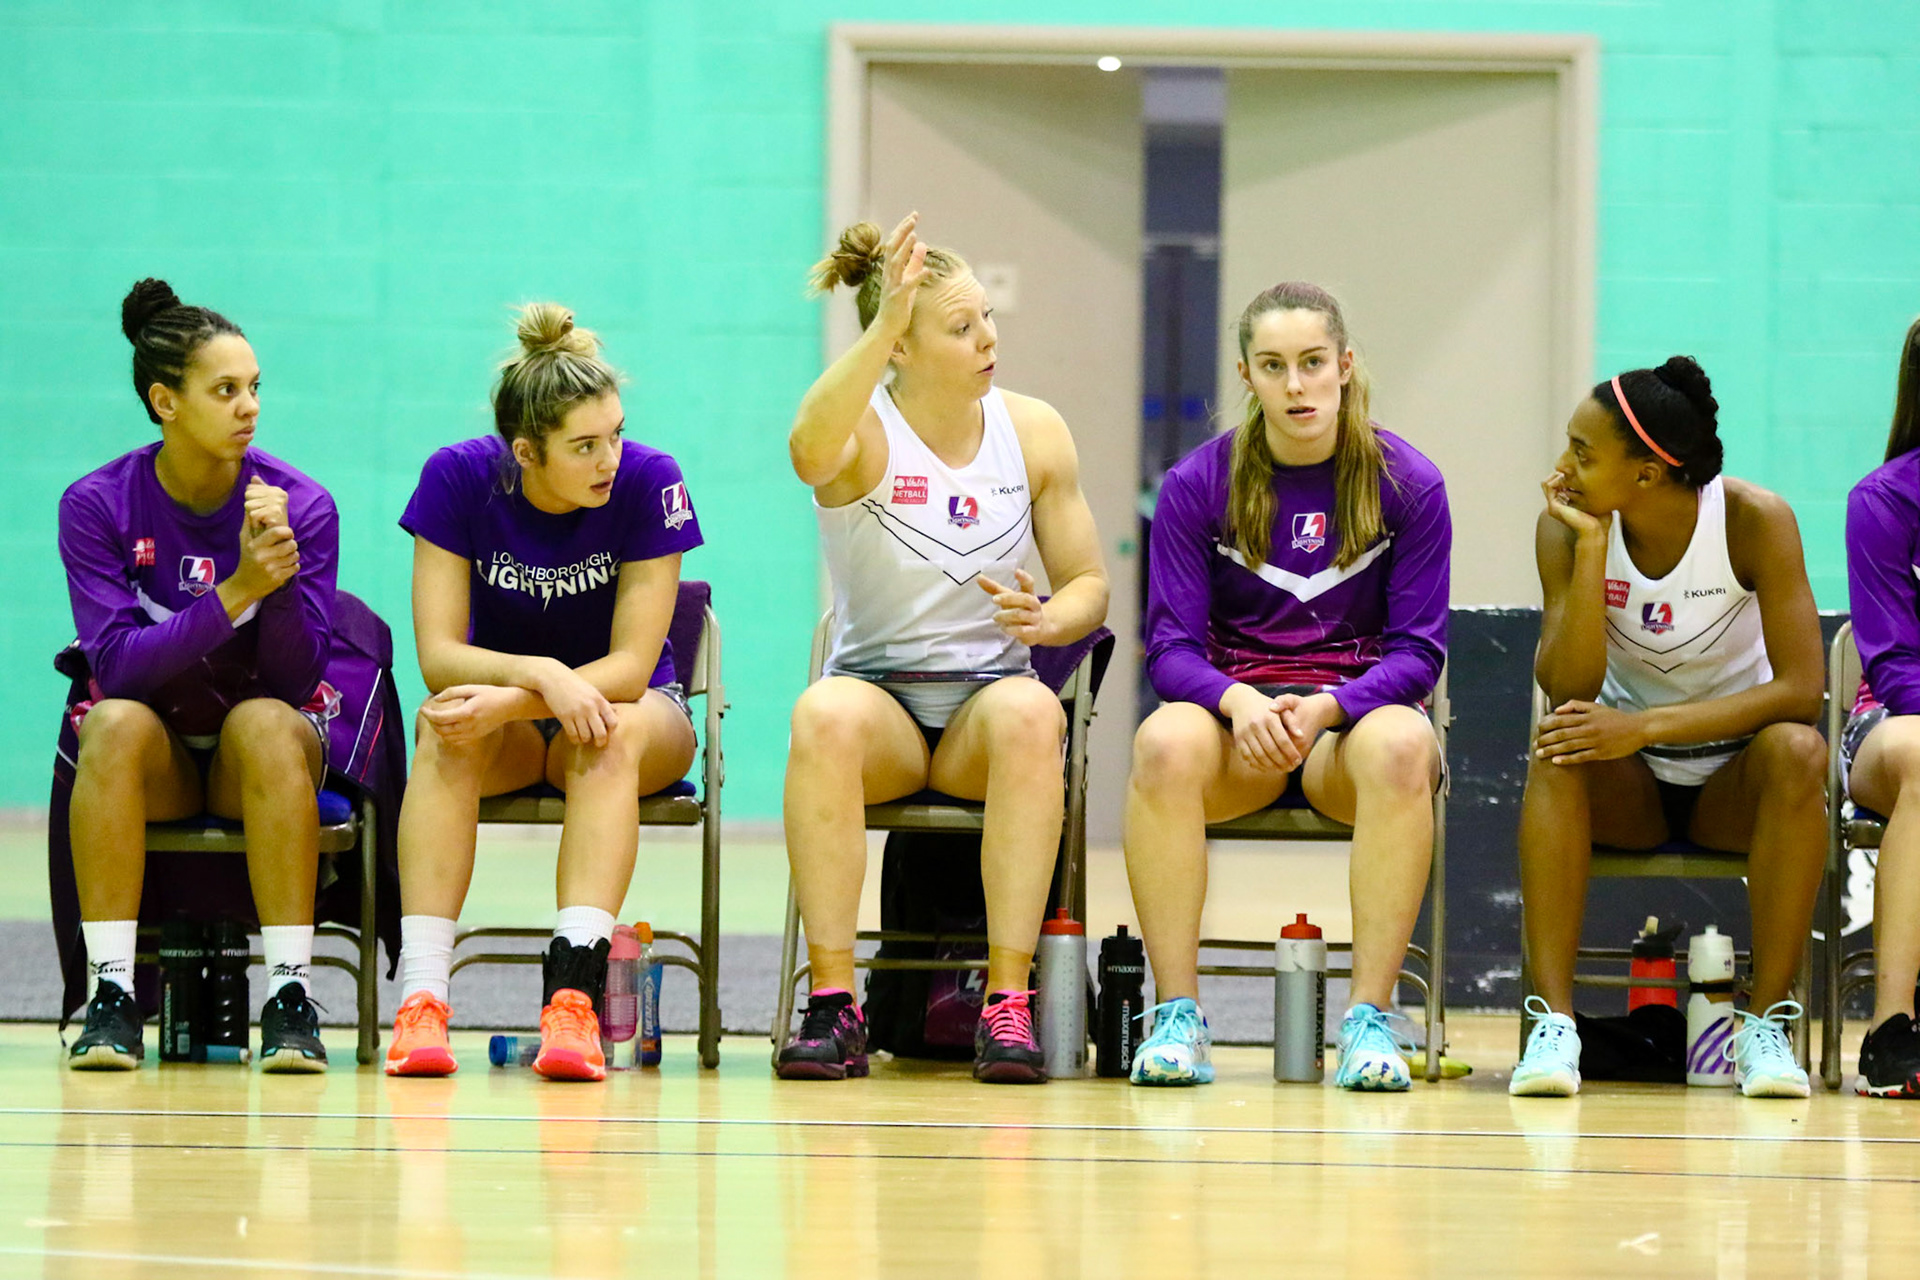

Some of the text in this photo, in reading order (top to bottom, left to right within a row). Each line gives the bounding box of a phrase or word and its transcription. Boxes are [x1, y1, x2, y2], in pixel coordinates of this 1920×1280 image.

[893, 490, 927, 498] NETBALL
[492, 551, 612, 580] LOUGHBOROUGH
[1691, 588, 1726, 598] KUKRI
[1121, 1005, 1130, 1070] maximuscle
